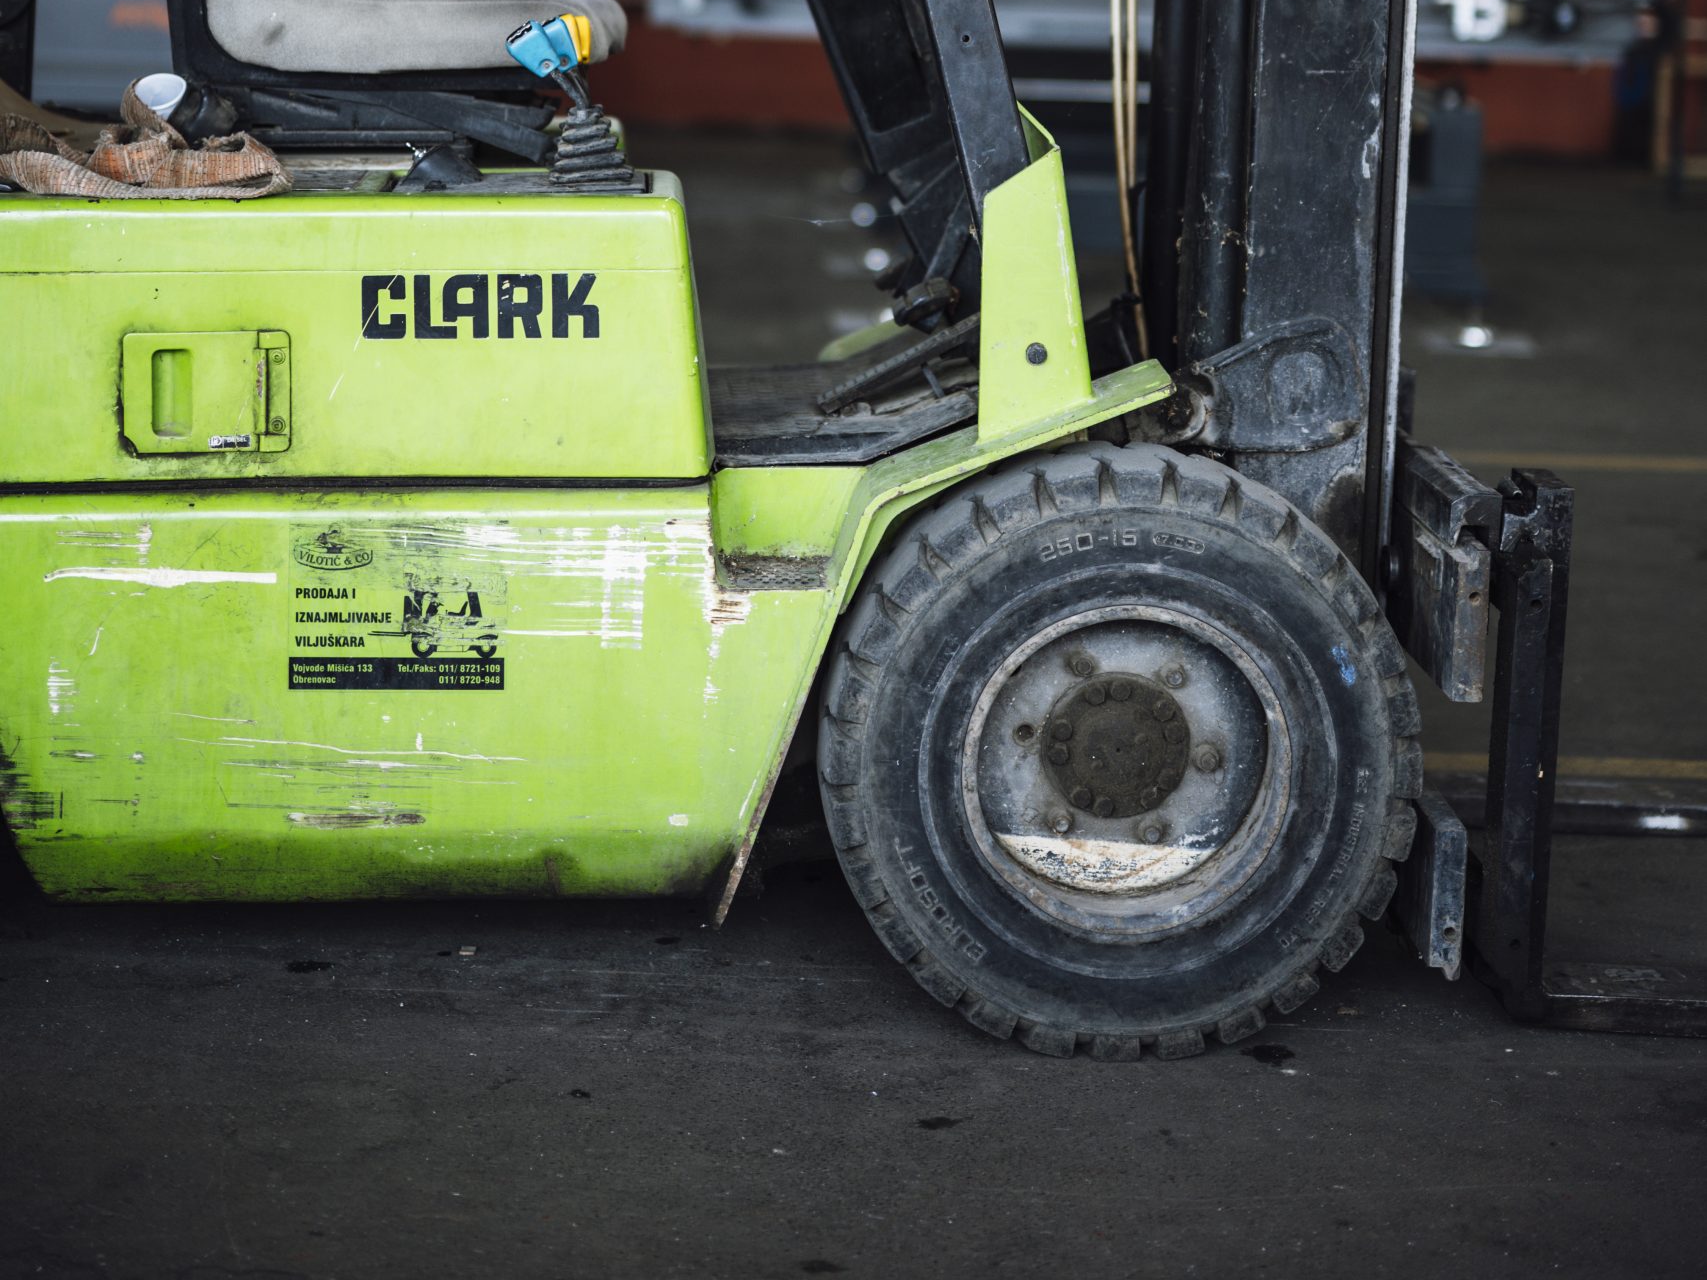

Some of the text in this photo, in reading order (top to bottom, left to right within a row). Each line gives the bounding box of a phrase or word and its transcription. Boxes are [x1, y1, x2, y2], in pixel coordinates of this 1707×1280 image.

[361, 273, 600, 339] CLARK
[300, 551, 370, 566] VILOTIĆ & CO
[295, 588, 356, 599] PRODAJA I
[295, 612, 392, 623] IZNAJMLJIVANJE
[295, 634, 365, 648] VILJUŠKARA
[293, 663, 373, 674] Vojvode Mišića 133
[397, 664, 500, 673] Tel./Faks: 011/ 8721-109
[293, 675, 336, 684] Obrenovac
[438, 676, 500, 684] 011/ 8720-948
